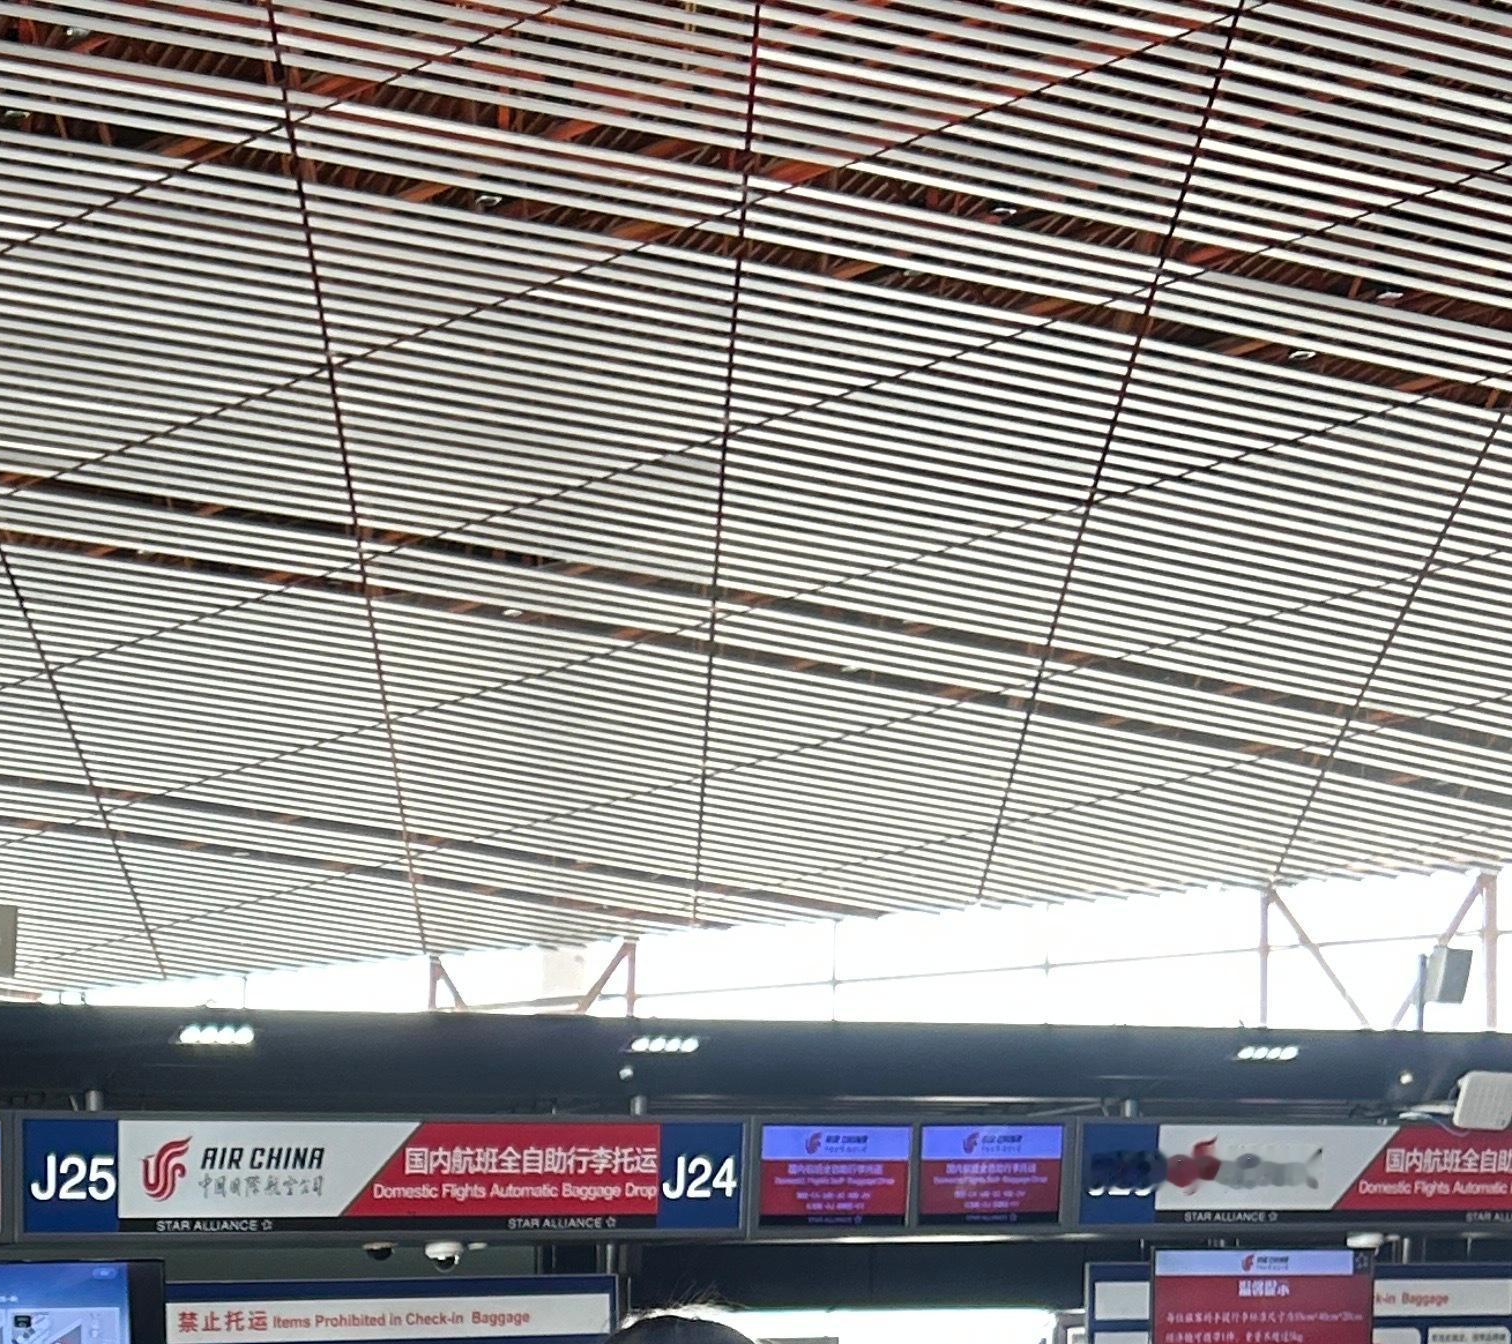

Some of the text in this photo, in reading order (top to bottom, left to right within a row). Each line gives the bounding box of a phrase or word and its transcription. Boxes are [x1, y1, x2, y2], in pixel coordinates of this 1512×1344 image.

[200, 1146, 326, 1171] AIR CHINA
[404, 1146, 658, 1176] 国内航班全自助行李托运
[30, 1153, 117, 1202] J25
[661, 1155, 738, 1200] J24
[373, 1183, 658, 1201] Domestic Flights Automatic Baggage Drop
[1358, 1180, 1508, 1197] Domestic Flights Automatic
[156, 1219, 260, 1232] STAR ALLIANCE
[507, 1217, 603, 1230] STAR ALLIANCE
[1184, 1211, 1266, 1223] STAR ALLIANCE
[1401, 1291, 1449, 1307] Baggage
[177, 1310, 531, 1333] 禁止托运 Items Prohibited in Check-in Baggage
